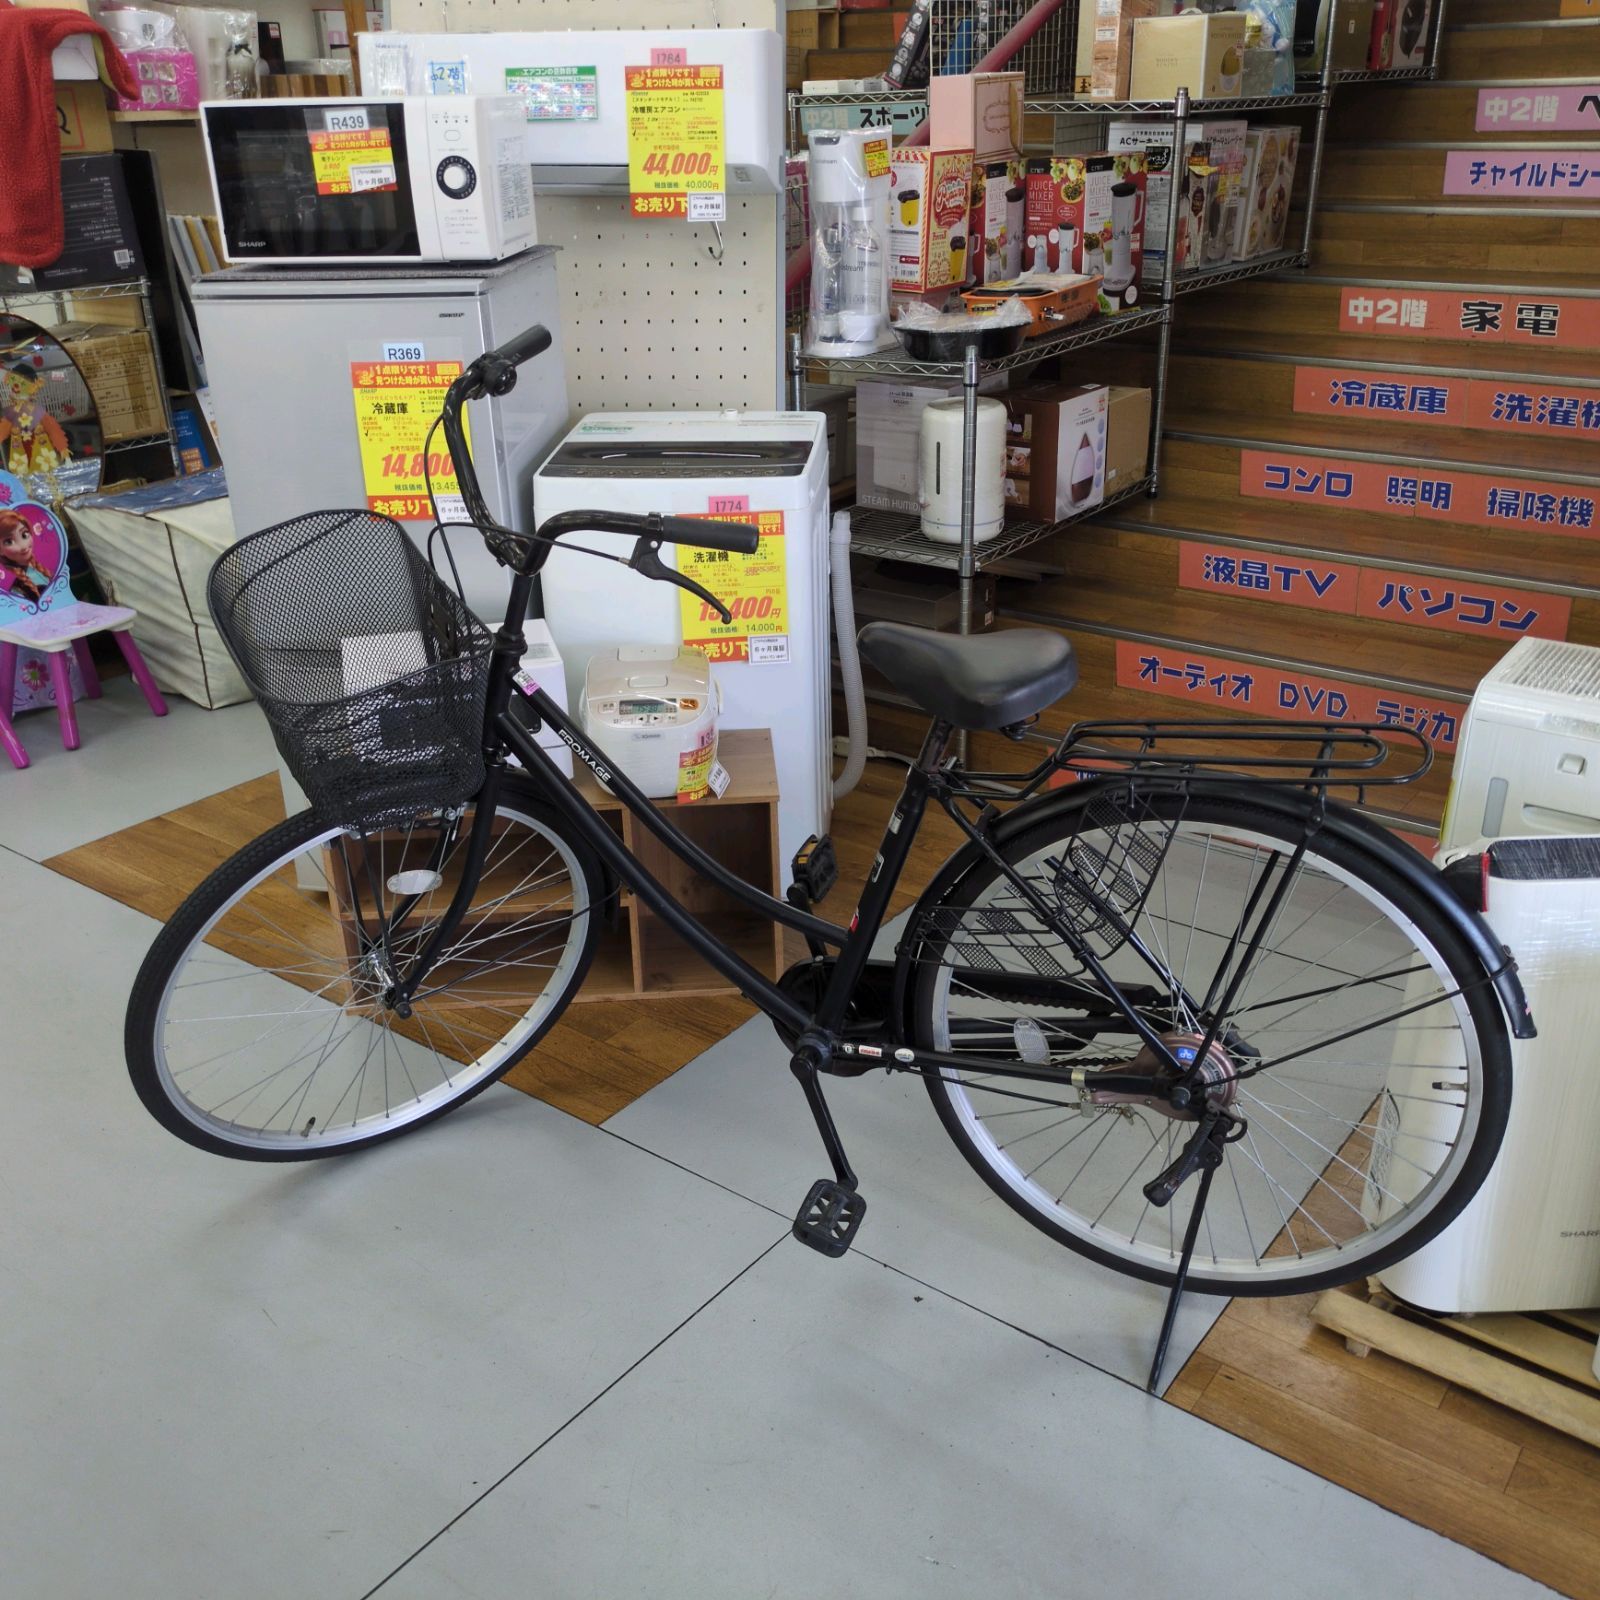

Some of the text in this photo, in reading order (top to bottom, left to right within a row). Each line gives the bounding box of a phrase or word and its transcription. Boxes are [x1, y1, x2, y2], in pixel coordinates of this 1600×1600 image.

[860, 106, 926, 129] スポーツ
[1484, 95, 1559, 123] 中2階
[331, 116, 364, 130] R439
[642, 152, 719, 177] 44,000円
[1029, 180, 1054, 191] JUICE
[1029, 192, 1054, 201] MIXER
[1348, 296, 1560, 338] 中2階 家電
[388, 347, 421, 360] R369
[371, 402, 408, 415] 冷蔵庫
[1328, 380, 1448, 415] 冷蔵庫
[1264, 464, 1596, 529] コンロ 照明 掃除機
[694, 550, 730, 563] 洗濯機
[1202, 553, 1539, 631] 液晶TV パソコン
[1138, 655, 1255, 702] オーディオ
[1279, 682, 1350, 720] DVD
[558, 730, 611, 782] FROMAGE
